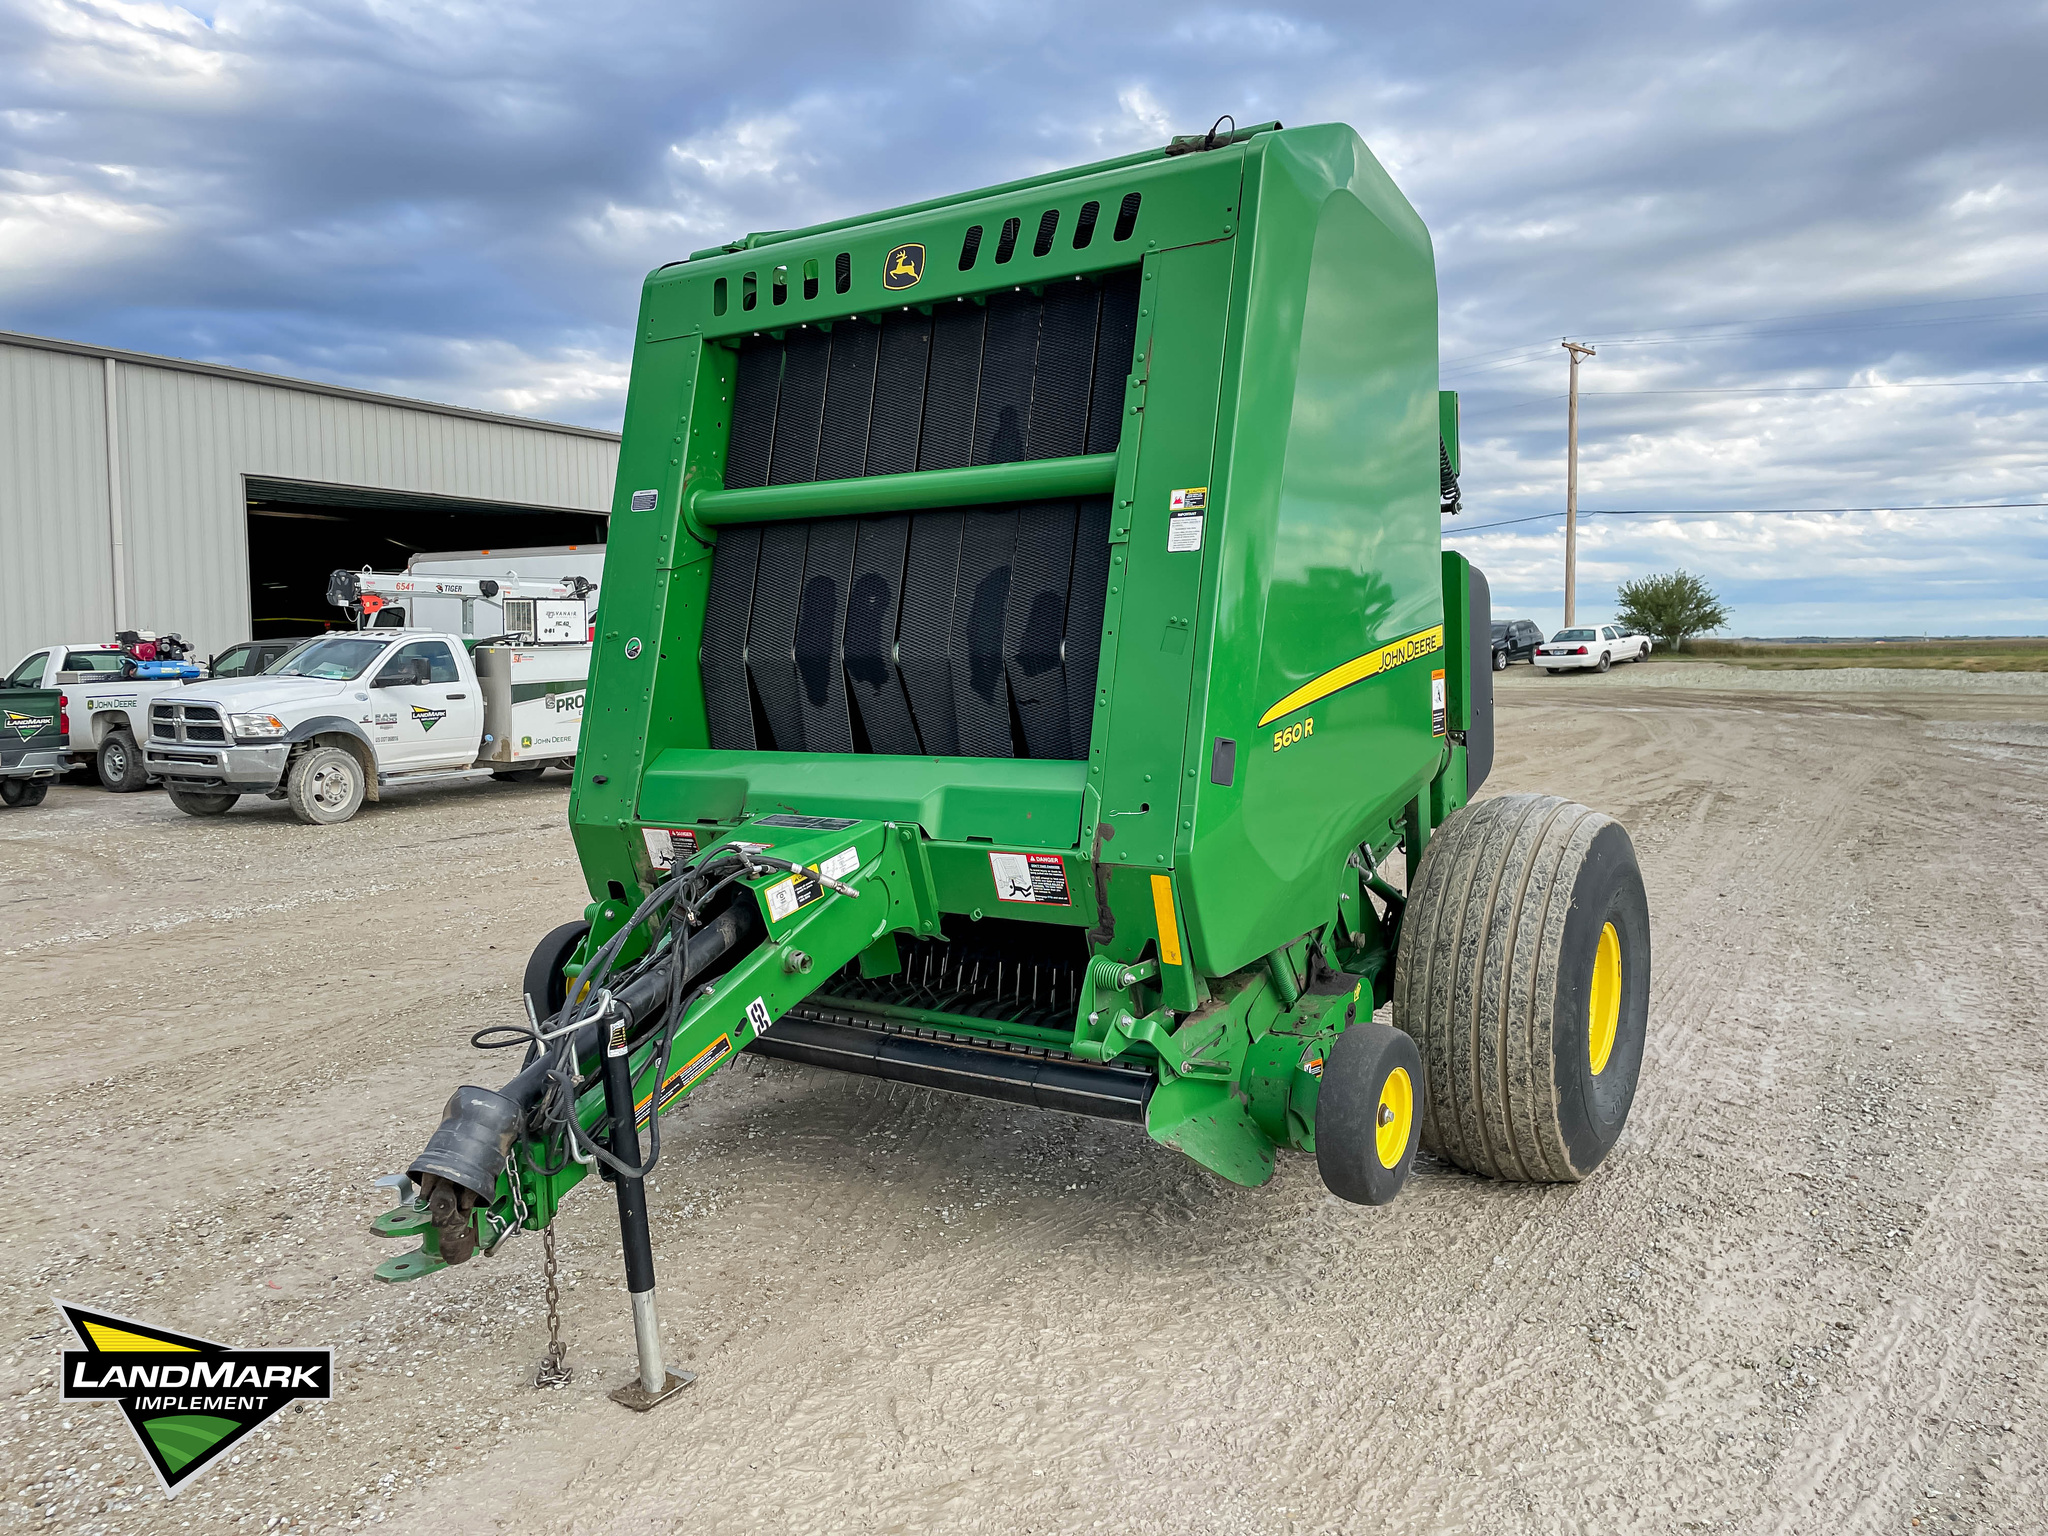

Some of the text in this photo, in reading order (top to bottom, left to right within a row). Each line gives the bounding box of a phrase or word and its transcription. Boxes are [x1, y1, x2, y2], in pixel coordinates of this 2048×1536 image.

[395, 582, 415, 591] 6541
[444, 584, 463, 593] TIGER
[1378, 635, 1437, 671] JOHN DEERE
[94, 700, 137, 709] JOHN DEERE
[7, 718, 51, 726] LANDMARK
[1273, 717, 1314, 753] 560 R
